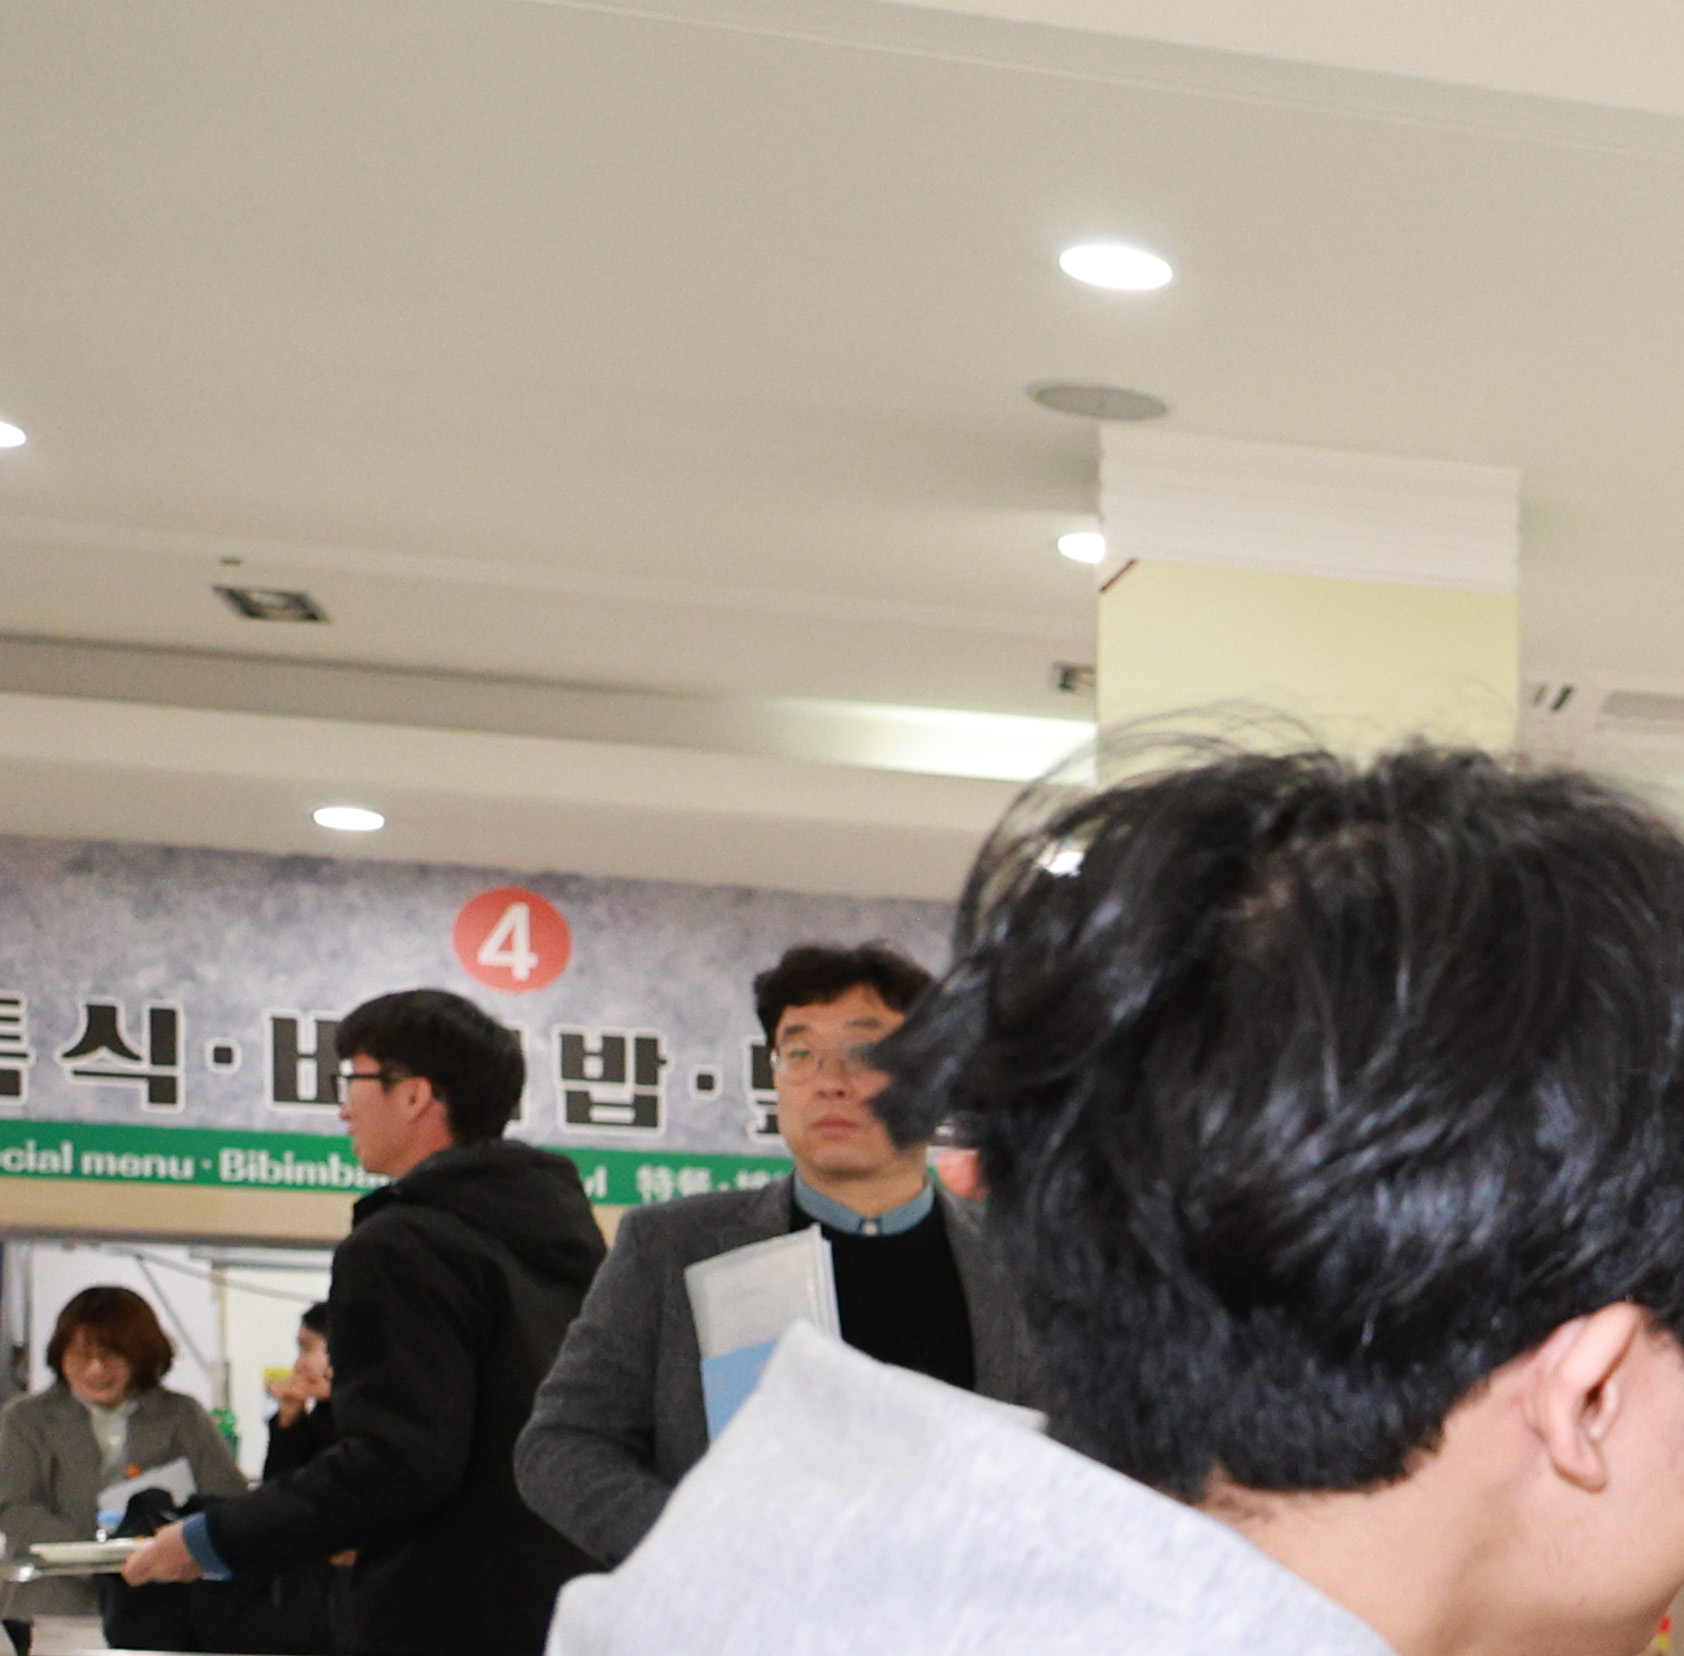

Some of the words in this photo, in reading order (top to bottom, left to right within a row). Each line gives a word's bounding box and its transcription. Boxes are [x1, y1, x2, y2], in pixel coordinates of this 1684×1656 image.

[477, 901, 539, 982] 4
[0, 1141, 73, 1175] cial
[81, 1151, 195, 1181] menu
